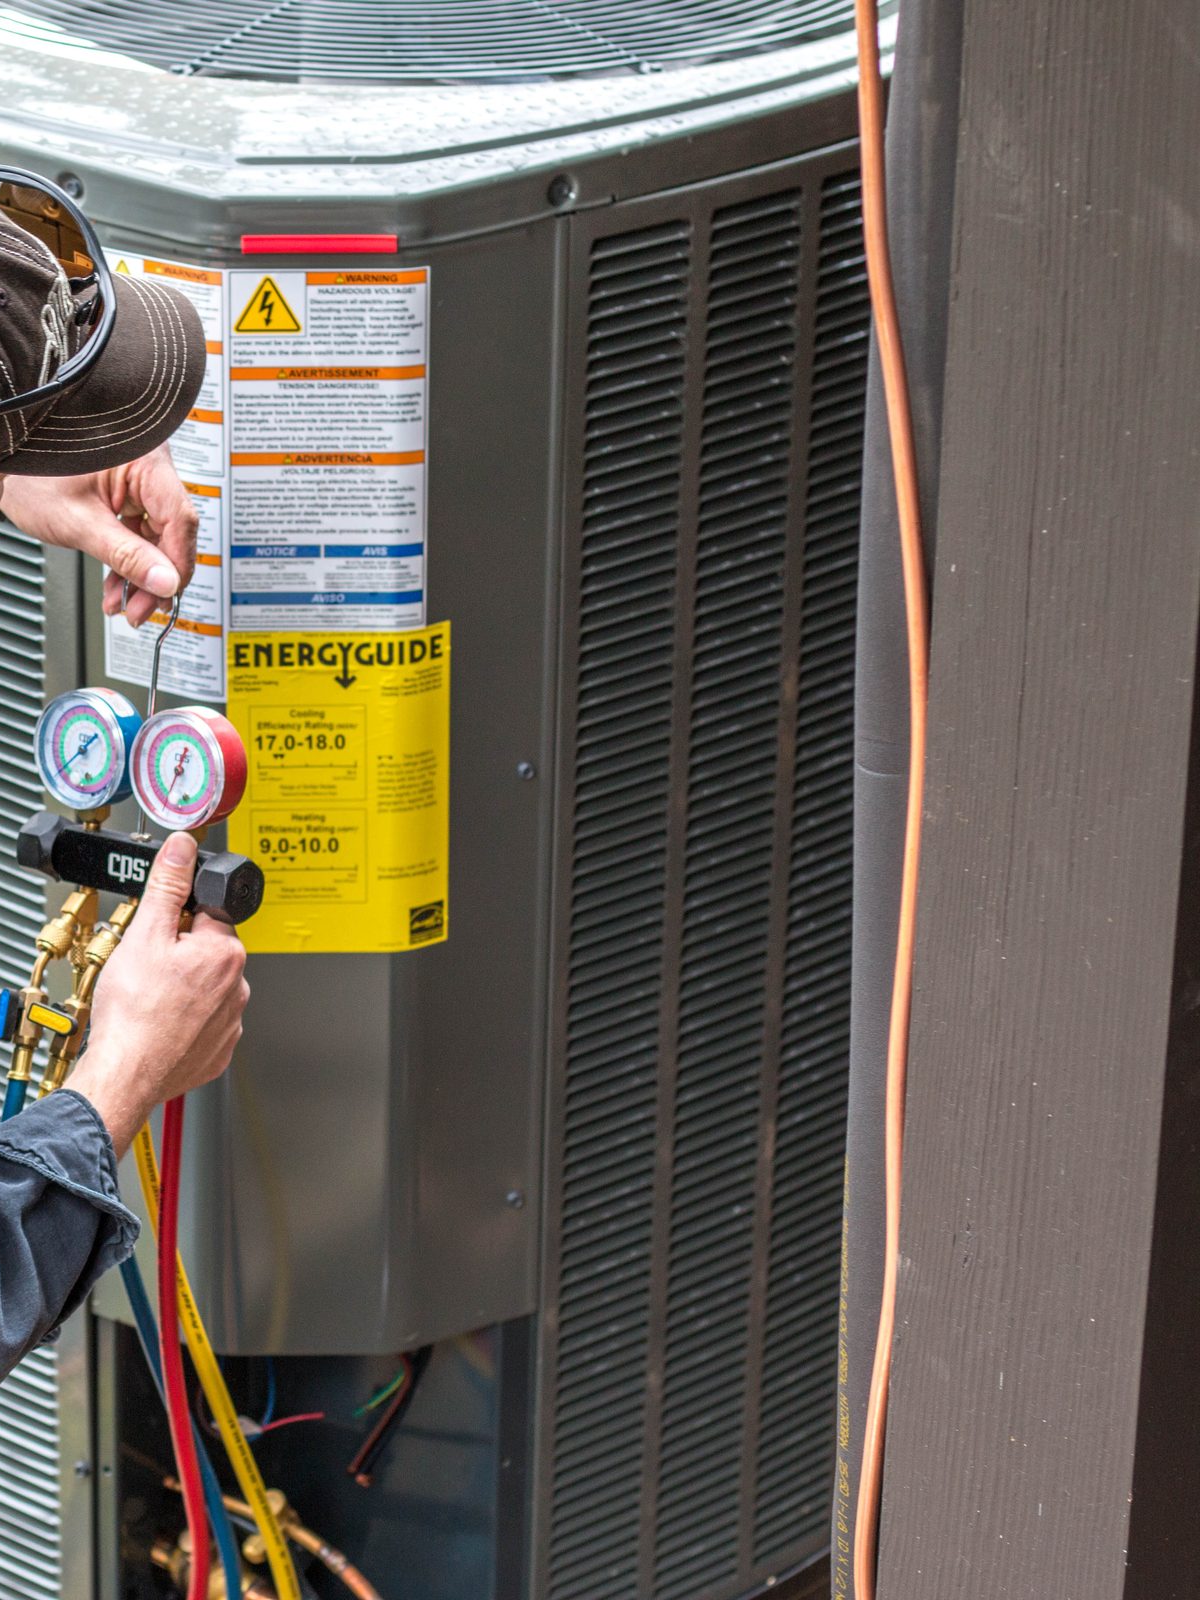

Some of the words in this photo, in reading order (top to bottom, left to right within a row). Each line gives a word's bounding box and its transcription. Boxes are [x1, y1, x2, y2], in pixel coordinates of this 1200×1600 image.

[346, 274, 398, 283] WARNING
[374, 287, 416, 295] VOLTAGE!
[288, 369, 380, 378] AVERTISSEMENT
[295, 455, 372, 463] ADVERTENCIA
[255, 547, 297, 556] NOTICE
[362, 547, 388, 556] AVIS
[311, 594, 345, 603] AVISO
[233, 634, 444, 670] ENERGYGUIDE
[290, 709, 325, 719] Cooling
[257, 722, 301, 731] Efficiency
[304, 722, 334, 731] Rating
[255, 734, 346, 750] 17.0-18.0
[291, 814, 325, 822] Heating
[259, 826, 302, 835] Efficiency
[306, 825, 335, 834] Rating
[260, 838, 339, 854] 9.0-10.0
[835, 1567, 848, 1589] 1/2
